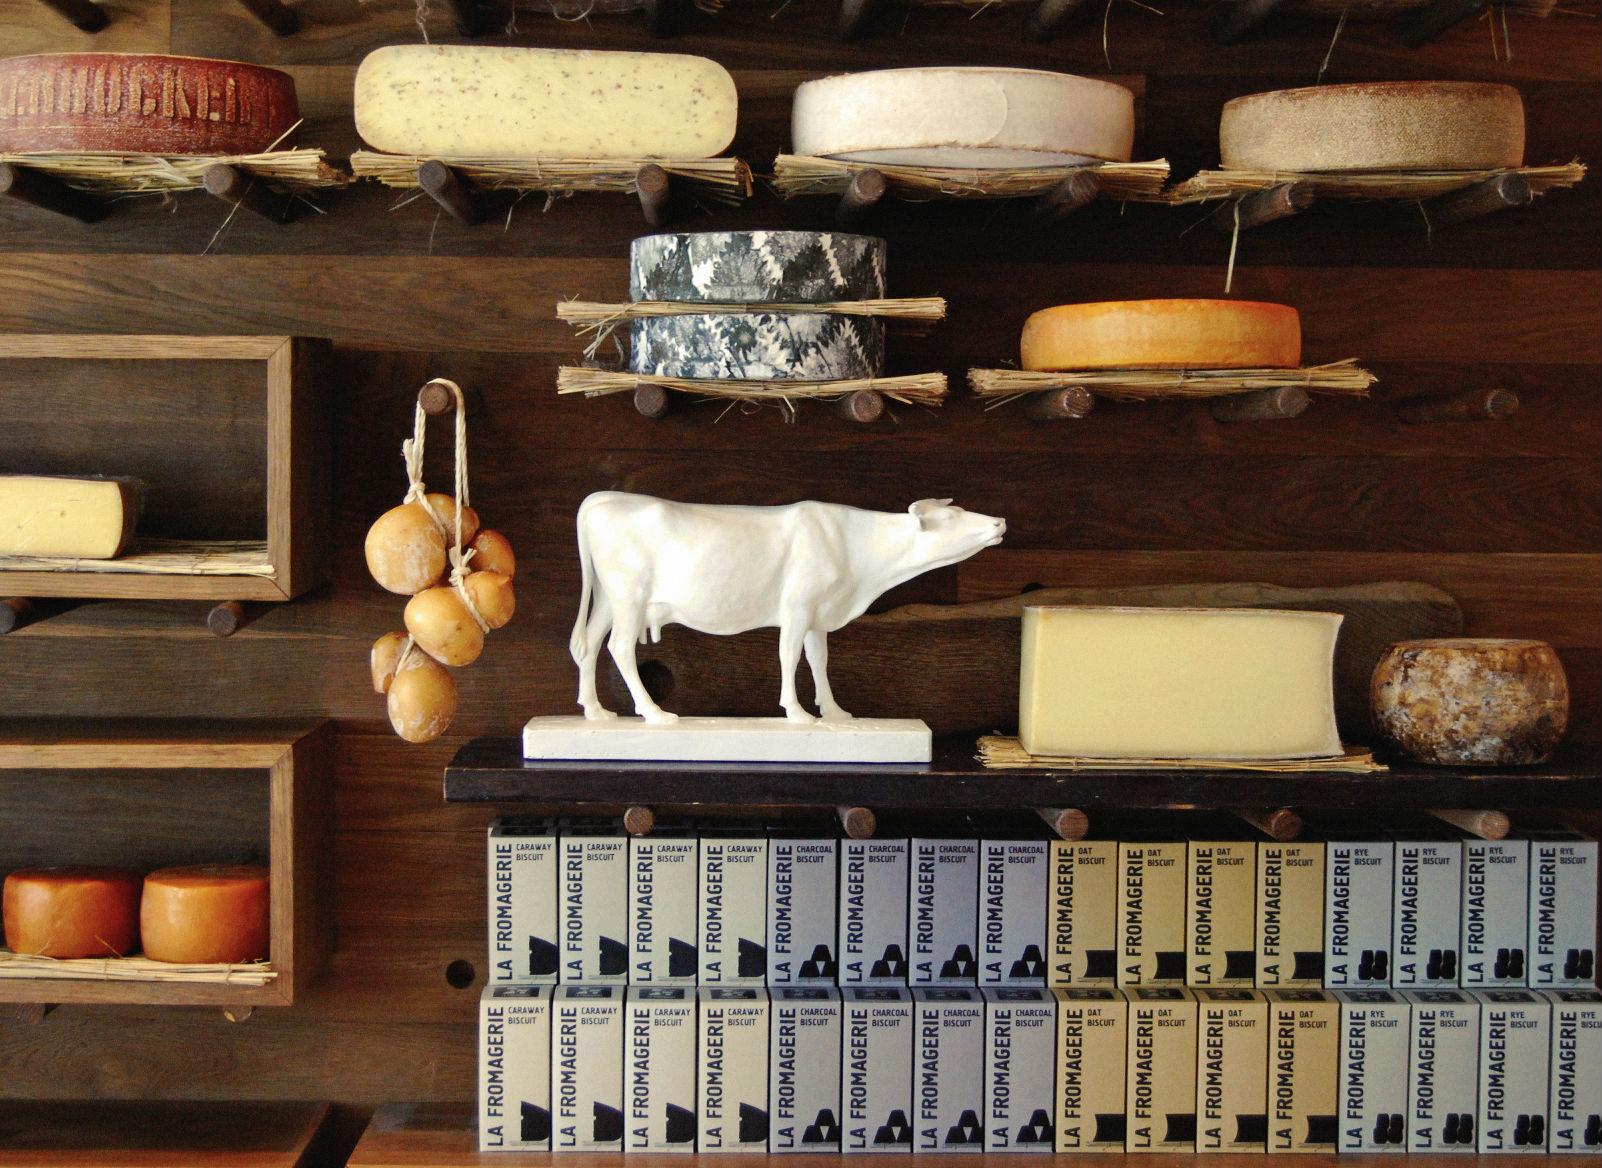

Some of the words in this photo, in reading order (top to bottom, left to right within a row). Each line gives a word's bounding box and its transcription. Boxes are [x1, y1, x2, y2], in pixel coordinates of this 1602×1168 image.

[1560, 856, 1587, 864] BISCUIT
[497, 844, 512, 951] FROMAGERIE
[567, 844, 582, 951] FROMAGERIE
[637, 845, 653, 952] FROMAGERIE
[706, 846, 723, 953] FROMAGERIE
[776, 846, 792, 953] FROMAGERIE
[847, 846, 864, 953] FROMAGERIE
[917, 846, 935, 953] FROMAGERIE
[986, 847, 1004, 953] FROMAGERIE
[1056, 847, 1074, 954] FROMAGERIE
[1126, 850, 1143, 956] FROMAGERIE
[1195, 848, 1212, 955] FROMAGERIE
[1264, 849, 1281, 956] FROMAGERIE
[1333, 849, 1350, 956] FROMAGERIE
[1401, 848, 1418, 955] FROMAGERIE
[1468, 847, 1485, 954] FROMAGERIE
[1538, 848, 1556, 954] FROMAGERIE
[497, 960, 512, 980] LA
[567, 960, 582, 980] LA
[637, 961, 652, 981] LA
[706, 962, 721, 981] LA
[775, 962, 791, 982] LA
[847, 962, 862, 982] LA
[916, 962, 932, 982] LA
[986, 962, 1001, 982] LA
[1056, 963, 1071, 983] LA
[1125, 965, 1141, 985] LA
[1195, 964, 1211, 984] LA
[1263, 965, 1279, 985] LA
[1332, 964, 1347, 984] LA
[1400, 964, 1415, 983] LA
[1468, 962, 1483, 982] LA
[1538, 963, 1553, 983] LA
[488, 1007, 503, 1116] FROMAGERIE
[561, 1008, 576, 1117] FROMAGERIE
[633, 1009, 649, 1118] FROMAGERIE
[707, 1009, 723, 1118] FROMAGERIE
[779, 1009, 795, 1118] FROMAGERIE
[850, 1009, 867, 1119] FROMAGERIE
[922, 1010, 939, 1119] FROMAGERIE
[993, 1010, 1011, 1118] FROMAGERIE
[1065, 1009, 1082, 1118] FROMAGERIE
[1135, 1010, 1153, 1118] FROMAGERIE
[1206, 1010, 1223, 1119] FROMAGERIE
[1277, 1011, 1295, 1119] FROMAGERIE
[1347, 1011, 1366, 1119] FROMAGERIE
[1417, 1011, 1435, 1119] FROMAGERIE
[1488, 1012, 1506, 1120] FROMAGERIE
[1558, 1012, 1576, 1120] FROMAGERIE
[488, 1126, 503, 1146] LA
[560, 1126, 576, 1146] LA
[633, 1127, 648, 1147] LA
[706, 1127, 721, 1147] LA
[778, 1127, 794, 1147] LA
[850, 1128, 866, 1148] LA
[921, 1128, 937, 1148] LA
[992, 1127, 1008, 1147] LA
[1064, 1127, 1080, 1147] LA
[1135, 1127, 1151, 1147] LA
[1205, 1128, 1221, 1148] LA
[1276, 1128, 1292, 1149] LA
[1346, 1128, 1362, 1148] LA
[1416, 1128, 1432, 1147] LA
[1487, 1129, 1503, 1149] LA
[1557, 1129, 1573, 1149] LA
